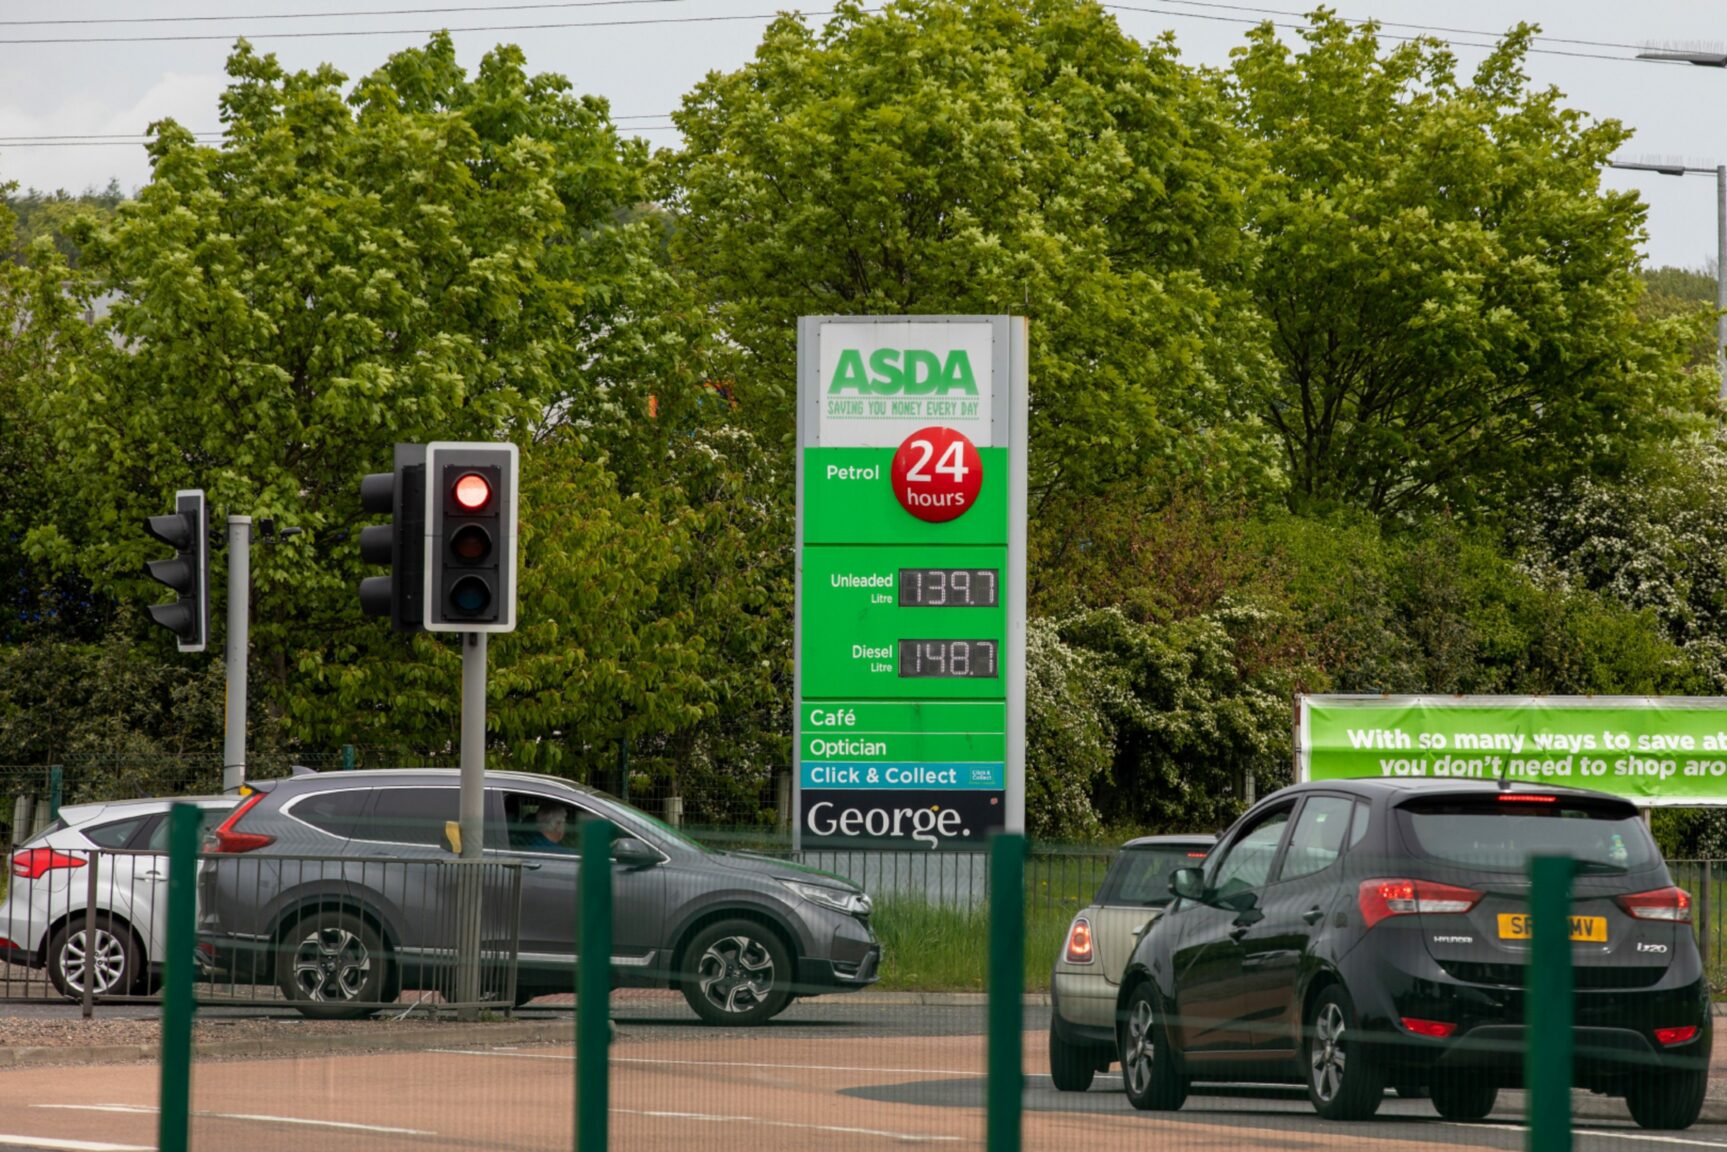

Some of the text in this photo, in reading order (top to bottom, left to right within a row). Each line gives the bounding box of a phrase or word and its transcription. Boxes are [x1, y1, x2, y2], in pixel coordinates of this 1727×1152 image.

[827, 348, 979, 396] ASDA
[828, 401, 979, 415] SAVING YOU MONEY EVERY DAY
[906, 440, 968, 483] 24
[827, 465, 879, 480] Petrol
[907, 488, 965, 507] hours
[831, 573, 893, 588] Unleaded
[915, 571, 995, 605] 139.7
[871, 594, 893, 604] Litre
[852, 645, 893, 659] Diesel
[915, 641, 994, 676] 148.7
[870, 663, 893, 673] Litre
[810, 709, 856, 726] Café
[810, 739, 887, 758] Optician
[1346, 729, 1727, 754] With so many ways to save at
[811, 767, 957, 784] Click & Collect
[1380, 759, 1427, 777] you
[1433, 754, 1502, 777] don't
[1509, 755, 1573, 776] need
[1580, 756, 1607, 776] to
[1614, 755, 1677, 780] shop
[807, 801, 971, 850] George.
